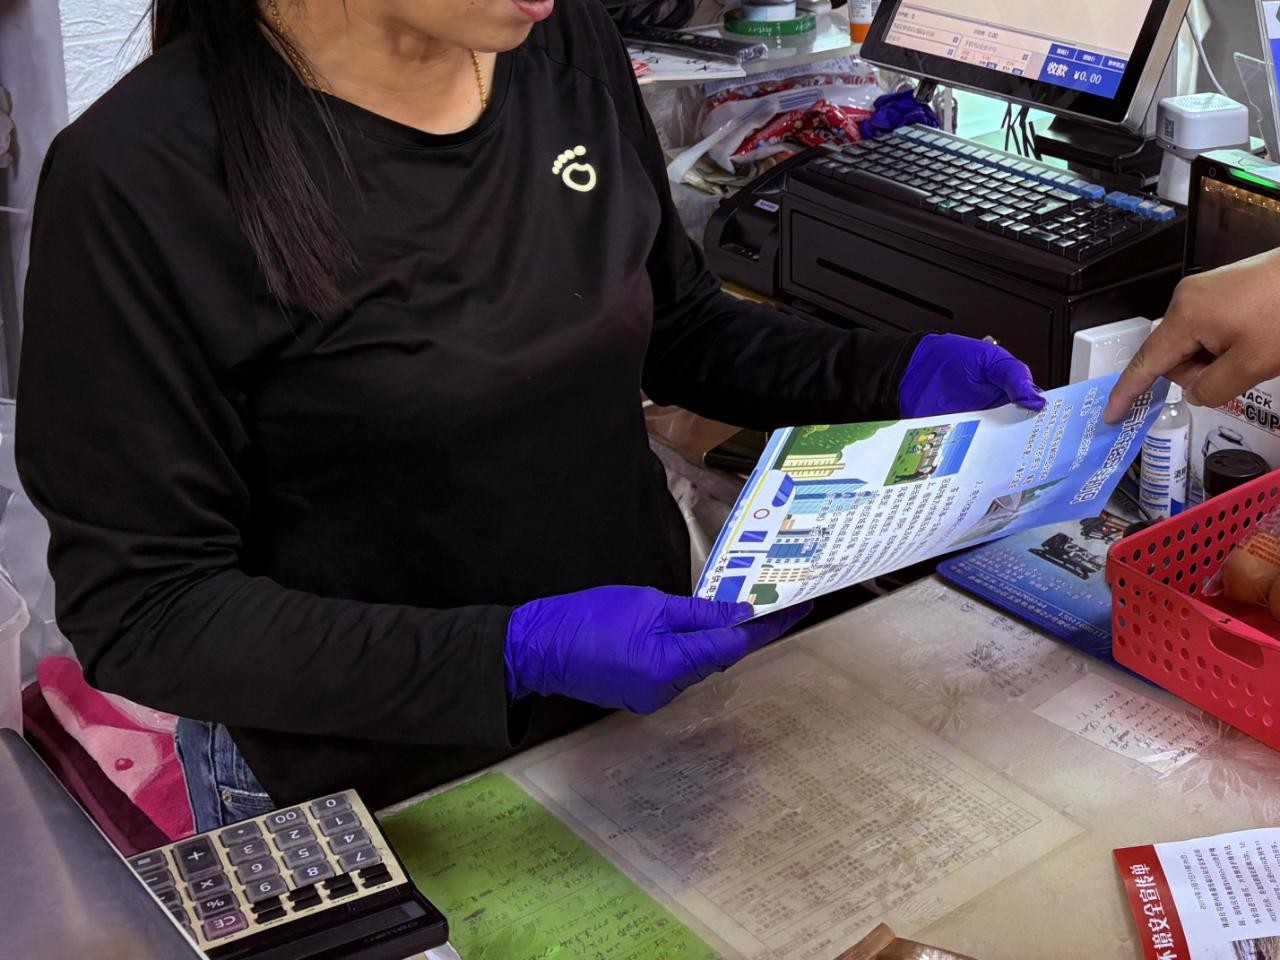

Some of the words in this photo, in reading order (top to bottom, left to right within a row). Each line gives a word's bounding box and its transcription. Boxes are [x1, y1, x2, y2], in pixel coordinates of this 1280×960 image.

[1046, 61, 1068, 77] 收款
[1245, 404, 1280, 432] CUP
[326, 799, 336, 808] 0
[275, 811, 296, 824] 00
[289, 830, 300, 839] 2
[243, 844, 254, 854] 3
[298, 848, 309, 858] 5
[307, 866, 318, 877] 8
[215, 916, 236, 929] CE
